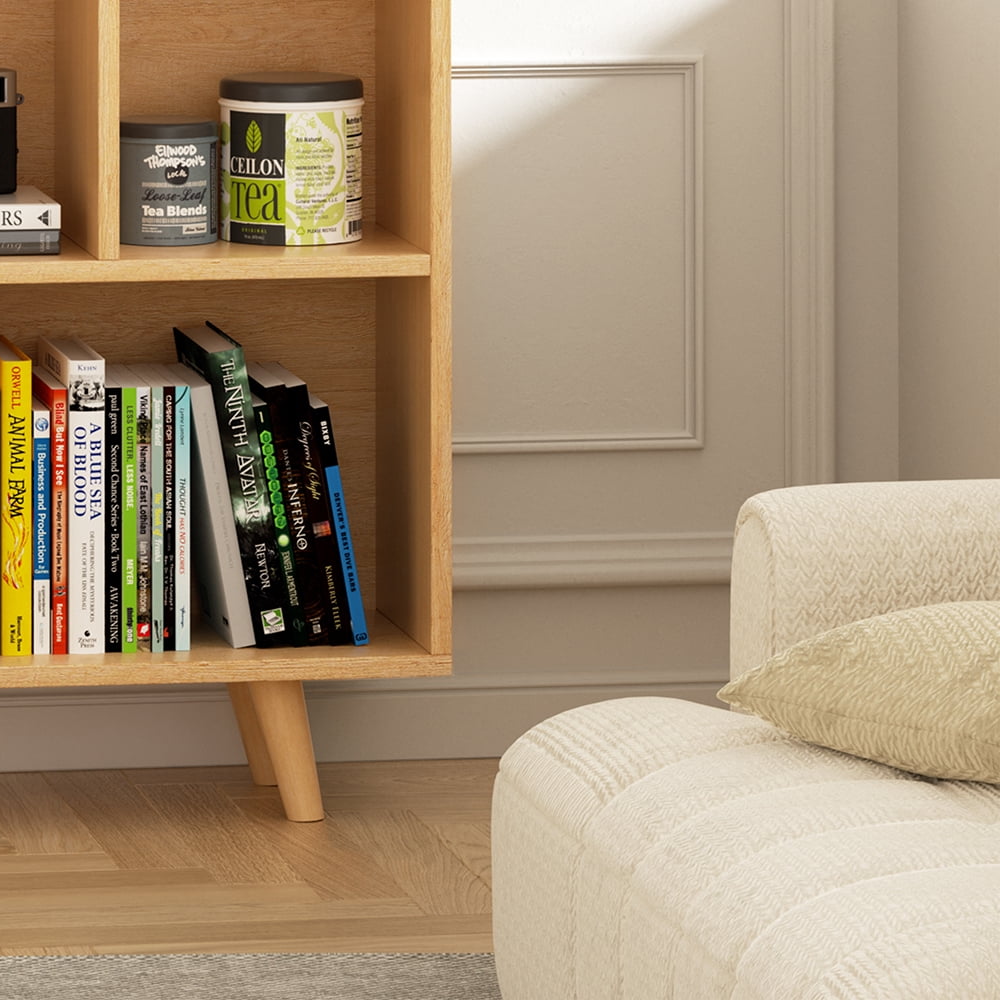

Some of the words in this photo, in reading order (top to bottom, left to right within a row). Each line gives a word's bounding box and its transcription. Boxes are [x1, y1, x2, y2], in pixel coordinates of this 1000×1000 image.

[230, 156, 283, 175] CEILON
[142, 188, 207, 204] Loose-Leaf
[142, 205, 164, 216] Tea
[166, 204, 207, 217] Blends
[11, 366, 21, 410] ORWELL
[55, 402, 64, 425] Blind
[109, 395, 119, 411] paul
[126, 406, 134, 424] LESS
[138, 395, 148, 420] Viking
[165, 395, 173, 423] CARING
[56, 426, 64, 442] But
[90, 423, 101, 434] A
[108, 413, 117, 434] green
[140, 421, 148, 443] Place
[165, 425, 173, 441] FOR
[320, 421, 331, 446] BIXBY
[8, 414, 26, 474] ANIMAL
[74, 427, 87, 450] OF
[126, 426, 134, 462] CLUTTER.
[165, 443, 173, 458] THE
[220, 359, 235, 386] THE
[236, 454, 260, 523] AVATAR
[298, 421, 312, 461] Degrees
[56, 445, 64, 463] Now
[90, 440, 101, 485] BLUE
[111, 445, 119, 472] Second
[140, 445, 148, 473] Names
[37, 452, 47, 491] Business
[56, 470, 64, 486] See
[126, 464, 134, 483] LESS
[165, 459, 173, 485] SOUTH
[304, 461, 315, 472] of
[74, 454, 87, 517] BLOOD
[111, 474, 119, 503] Chance
[140, 475, 148, 483] of
[306, 473, 321, 500] Sight
[8, 479, 26, 518] FARM
[37, 494, 47, 511] and
[90, 489, 101, 520] SEA
[126, 485, 134, 511] NOISE.
[140, 485, 148, 503] East
[165, 486, 173, 510] ASIAN
[111, 504, 119, 527] Series
[140, 504, 148, 534] Lothian
[288, 484, 308, 550] INFERNO
[333, 492, 345, 530] DENVER'S
[37, 513, 47, 563] Production
[111, 534, 119, 552] Book
[179, 531, 185, 544] NO
[341, 532, 349, 551] BEST
[111, 553, 119, 573] Two
[126, 559, 134, 585] MEYER
[255, 543, 271, 590] NEWTON
[345, 552, 353, 570] DIVE
[139, 574, 148, 612] Johnstone
[325, 565, 337, 606] KIMBERLY
[347, 571, 357, 593] BARS
[110, 586, 118, 643] AWAKENING
